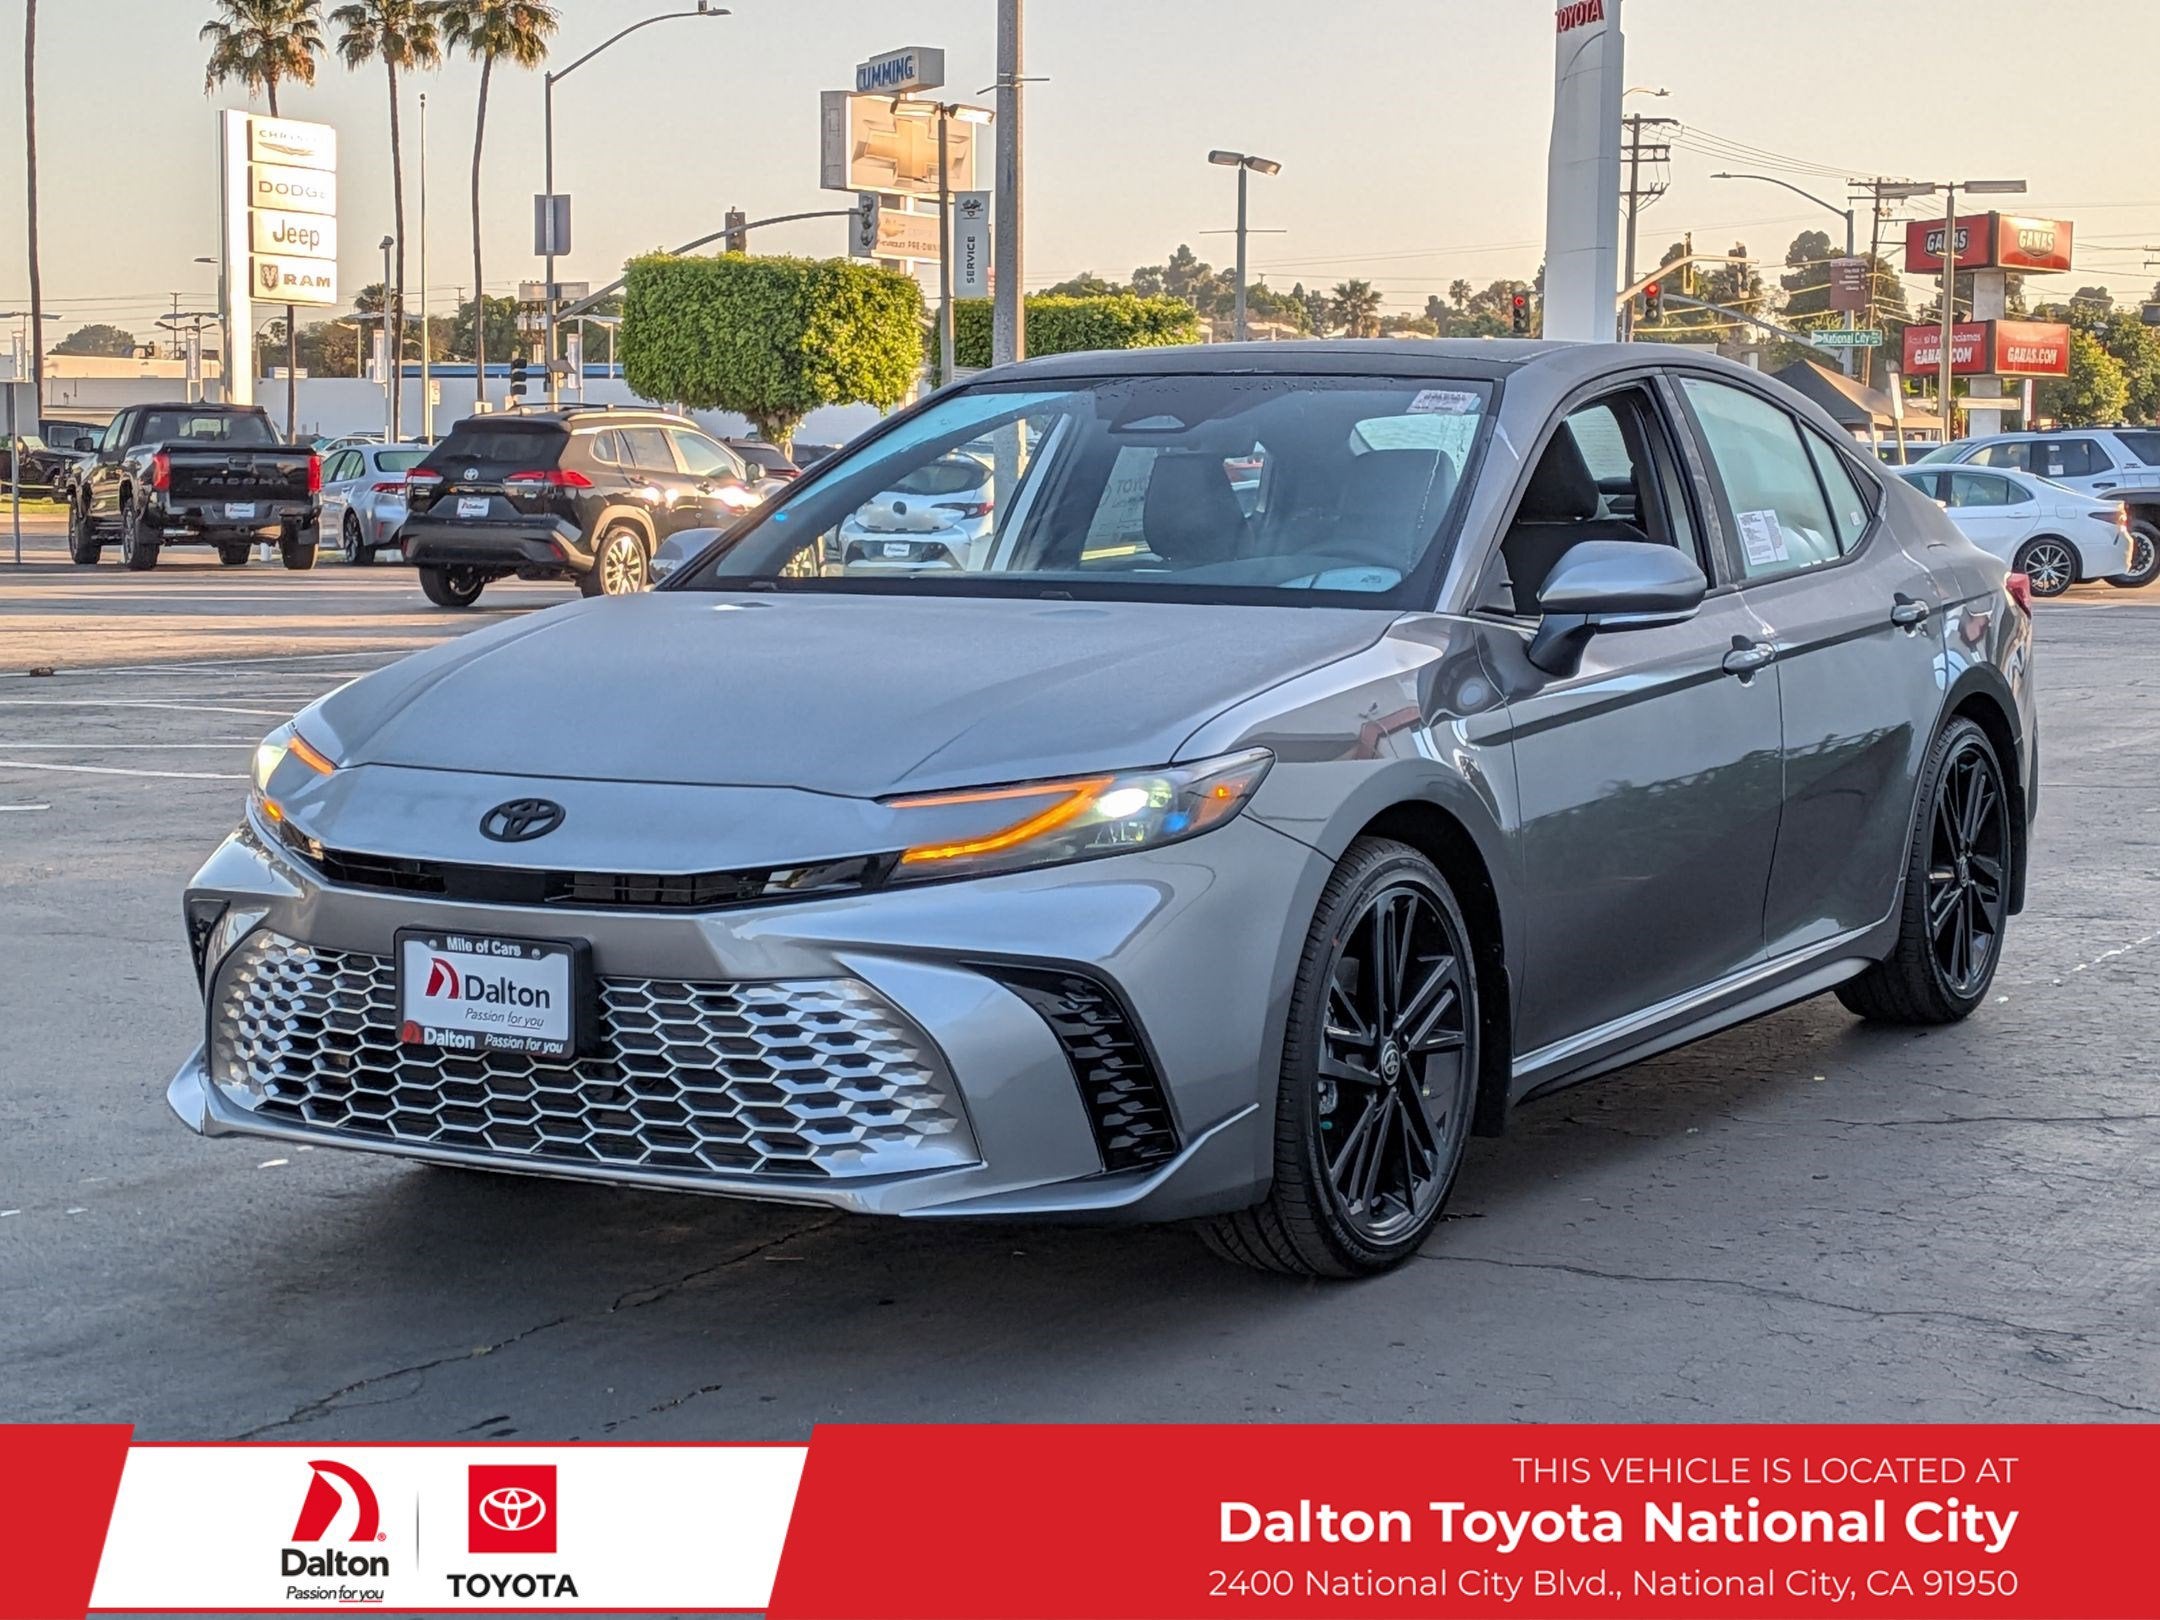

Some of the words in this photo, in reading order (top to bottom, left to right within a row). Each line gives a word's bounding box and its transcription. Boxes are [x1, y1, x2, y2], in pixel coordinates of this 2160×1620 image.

[1555, 0, 1604, 33] TOYOTA
[856, 55, 914, 92] CUMMING
[272, 219, 320, 251] Jeep
[1927, 230, 1967, 252] GAAS
[2018, 229, 2054, 252] GANAS
[965, 236, 976, 284] SERVICE
[283, 273, 330, 288] RAM
[1822, 332, 1854, 344] National
[1854, 332, 1870, 345] City
[1914, 346, 1973, 365] GANACOM
[192, 477, 288, 486] TACOMA
[446, 936, 473, 953] Mile
[475, 940, 489, 954] of
[490, 941, 522, 957] Cars
[465, 974, 550, 1009] Dalton
[465, 1007, 505, 1023] Passion
[507, 1011, 522, 1025] for
[524, 1016, 545, 1029] you
[423, 1027, 476, 1049] Dalton
[484, 1033, 524, 1050] Passion
[525, 1037, 542, 1051] for
[543, 1040, 564, 1055] you
